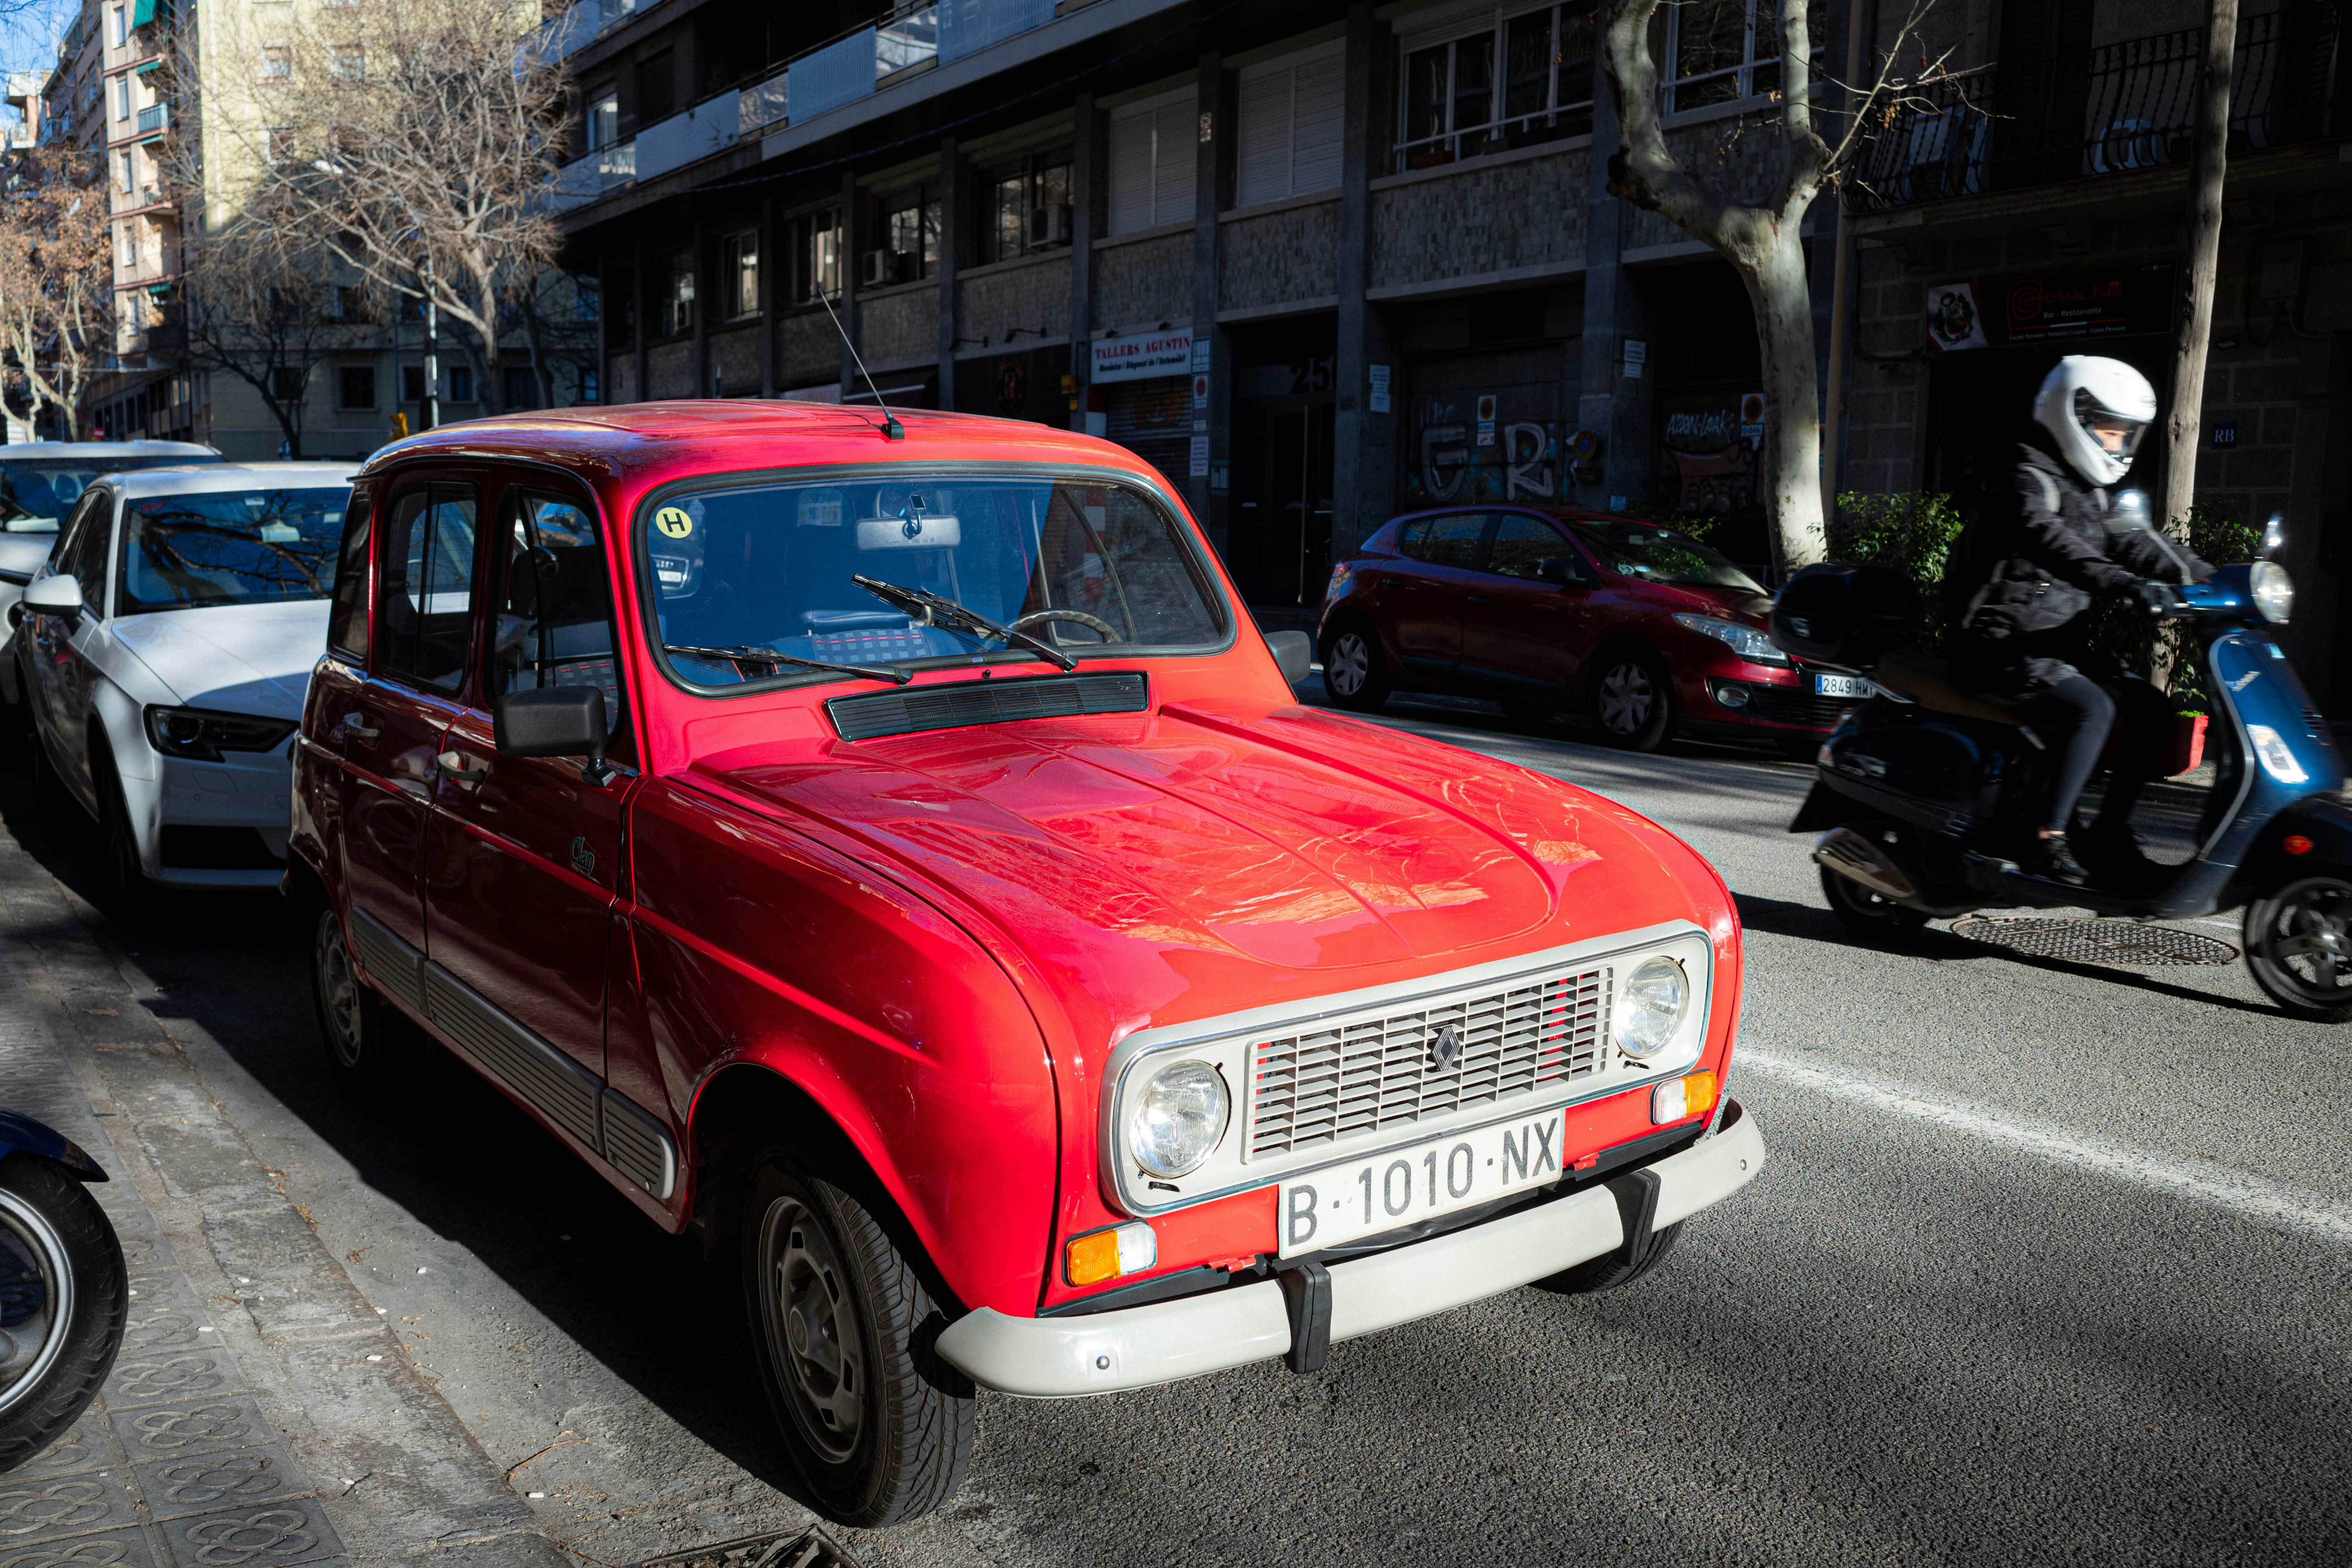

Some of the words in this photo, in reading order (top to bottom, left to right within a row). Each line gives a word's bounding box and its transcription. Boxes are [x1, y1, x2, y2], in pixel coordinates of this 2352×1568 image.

[2043, 311, 2055, 319] Bar
[2061, 307, 2102, 317] Restaurante
[1095, 344, 1139, 360] TALLERS
[1146, 336, 1190, 353] AGUSTIN
[2214, 429, 2234, 443] RB
[662, 513, 685, 532] H
[1823, 678, 1851, 694] 2849
[569, 836, 595, 876] Clan
